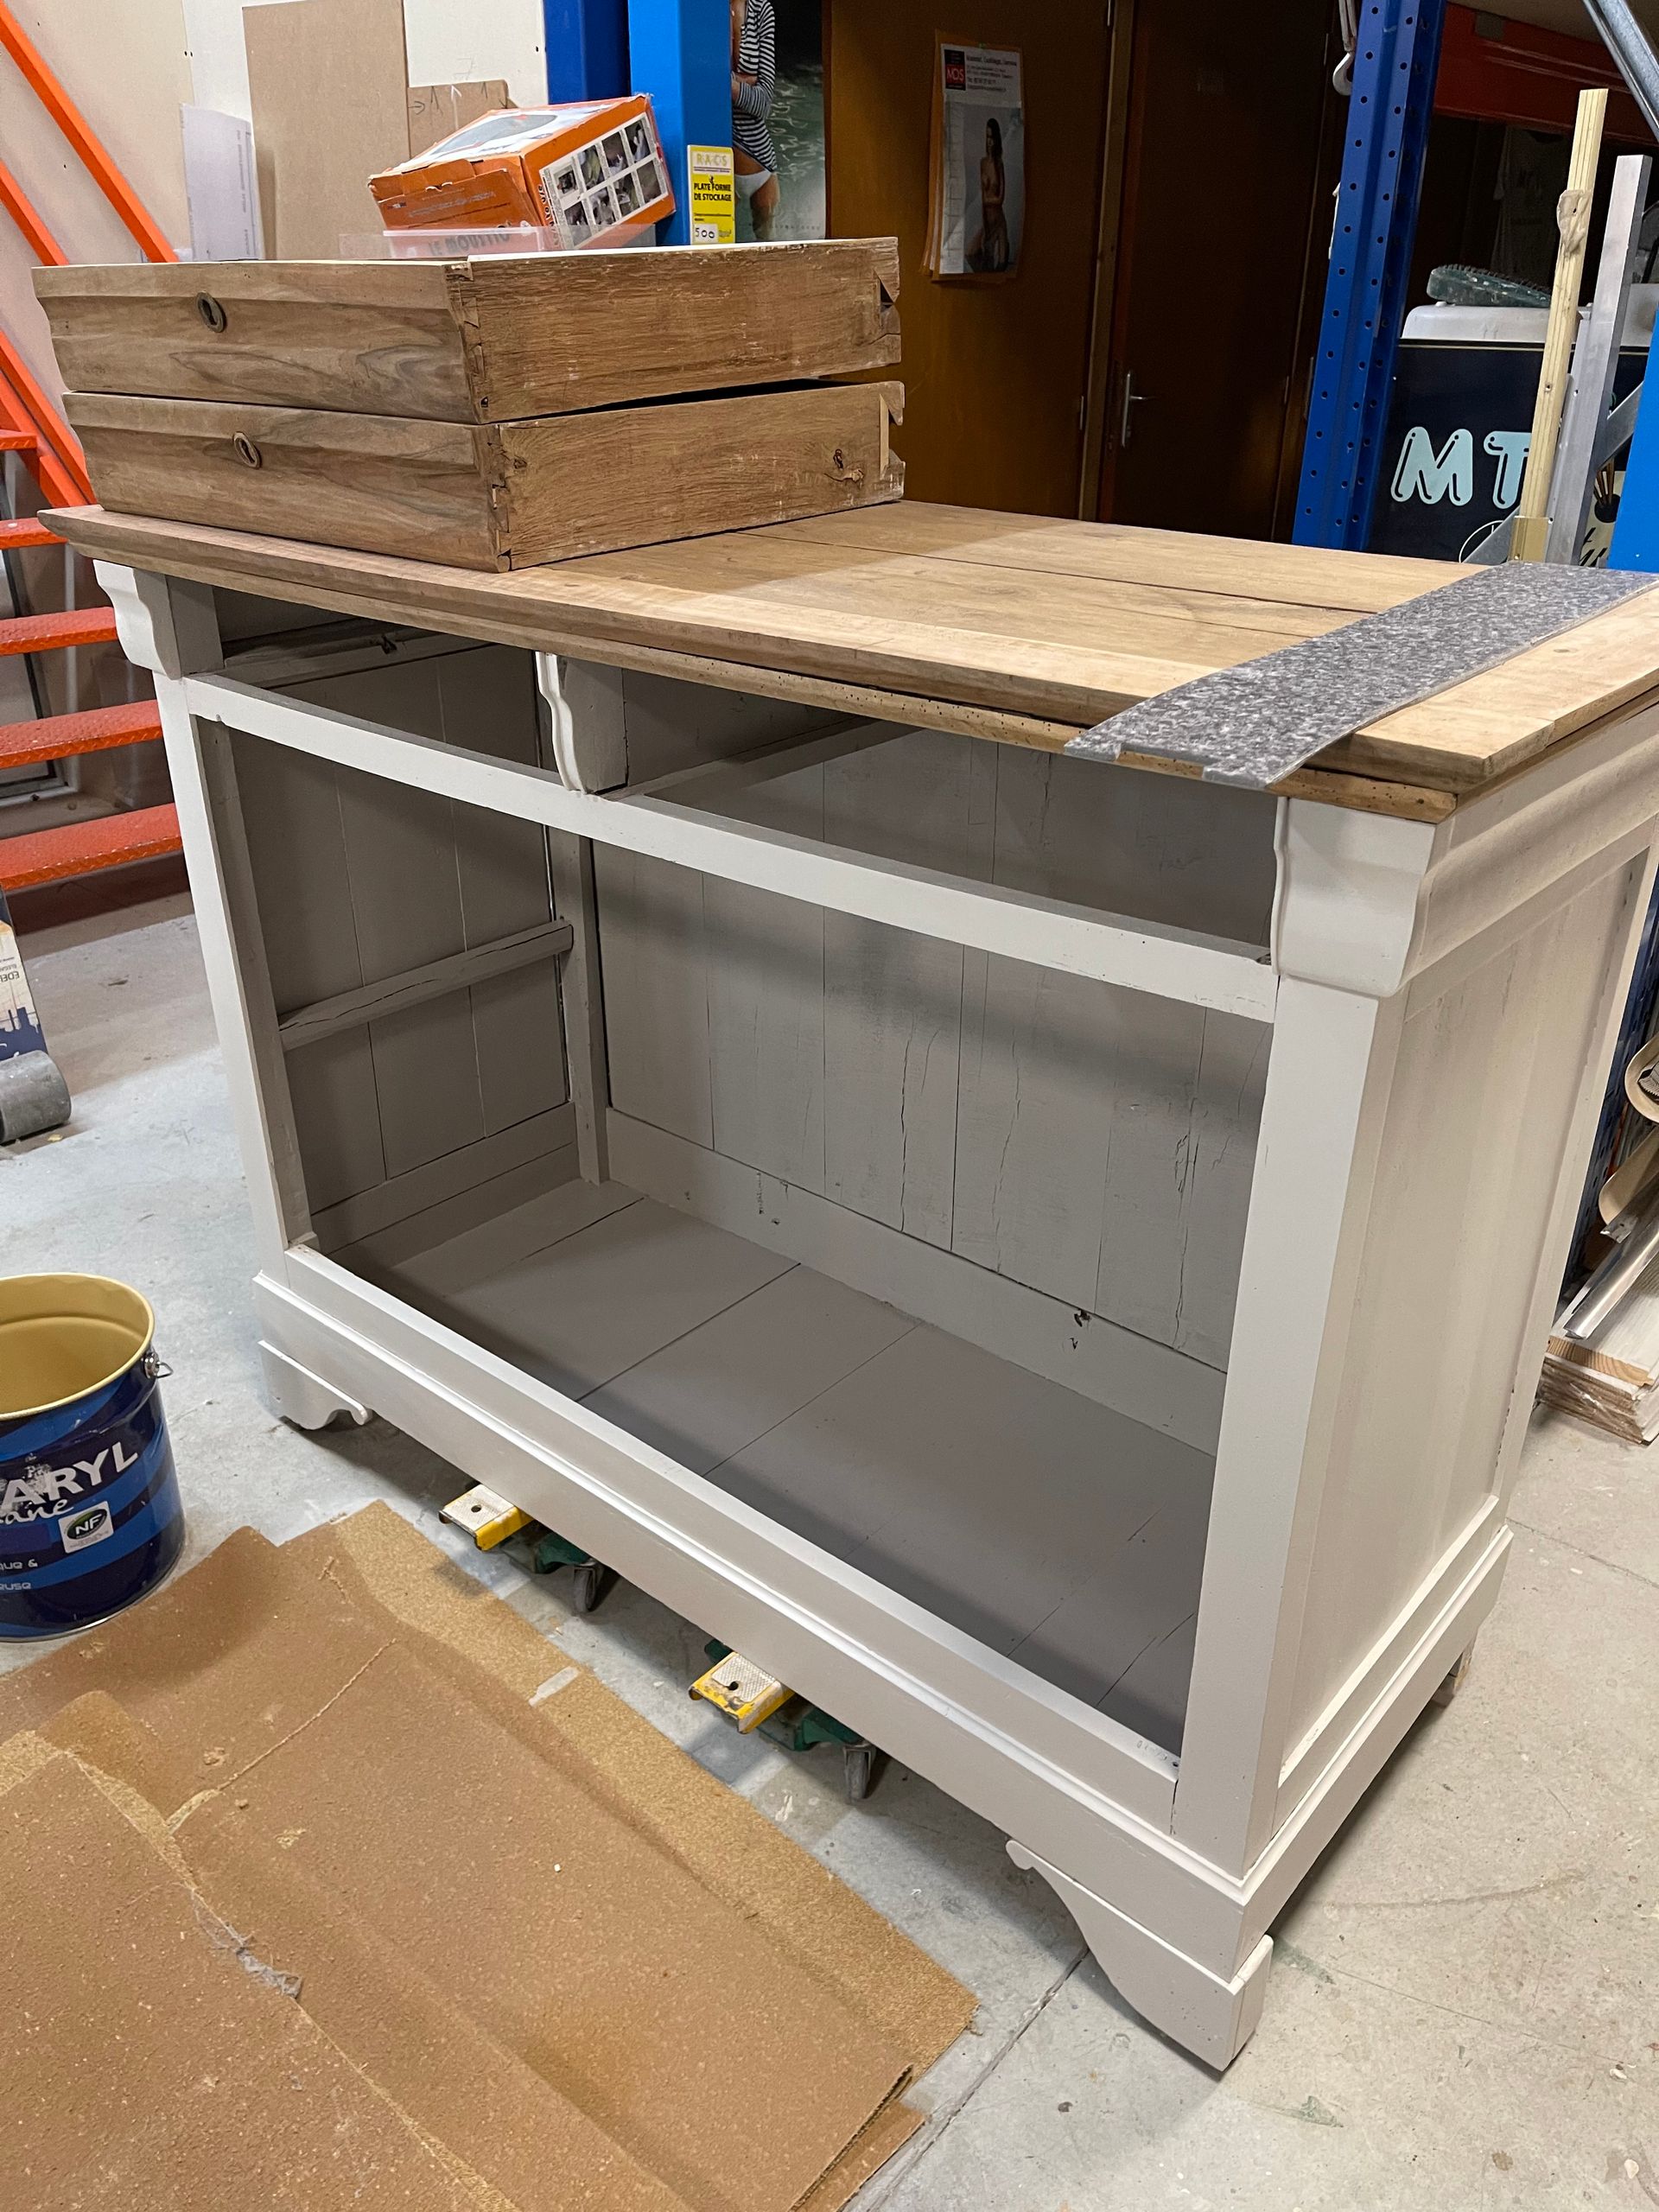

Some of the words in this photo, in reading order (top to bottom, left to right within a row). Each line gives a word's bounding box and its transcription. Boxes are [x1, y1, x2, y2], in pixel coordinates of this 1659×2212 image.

[694, 182, 711, 191] PLATE
[695, 227, 715, 238] 500
[0, 1499, 74, 1525] ane
[75, 1513, 103, 1535] NF
[28, 1559, 38, 1567] &
